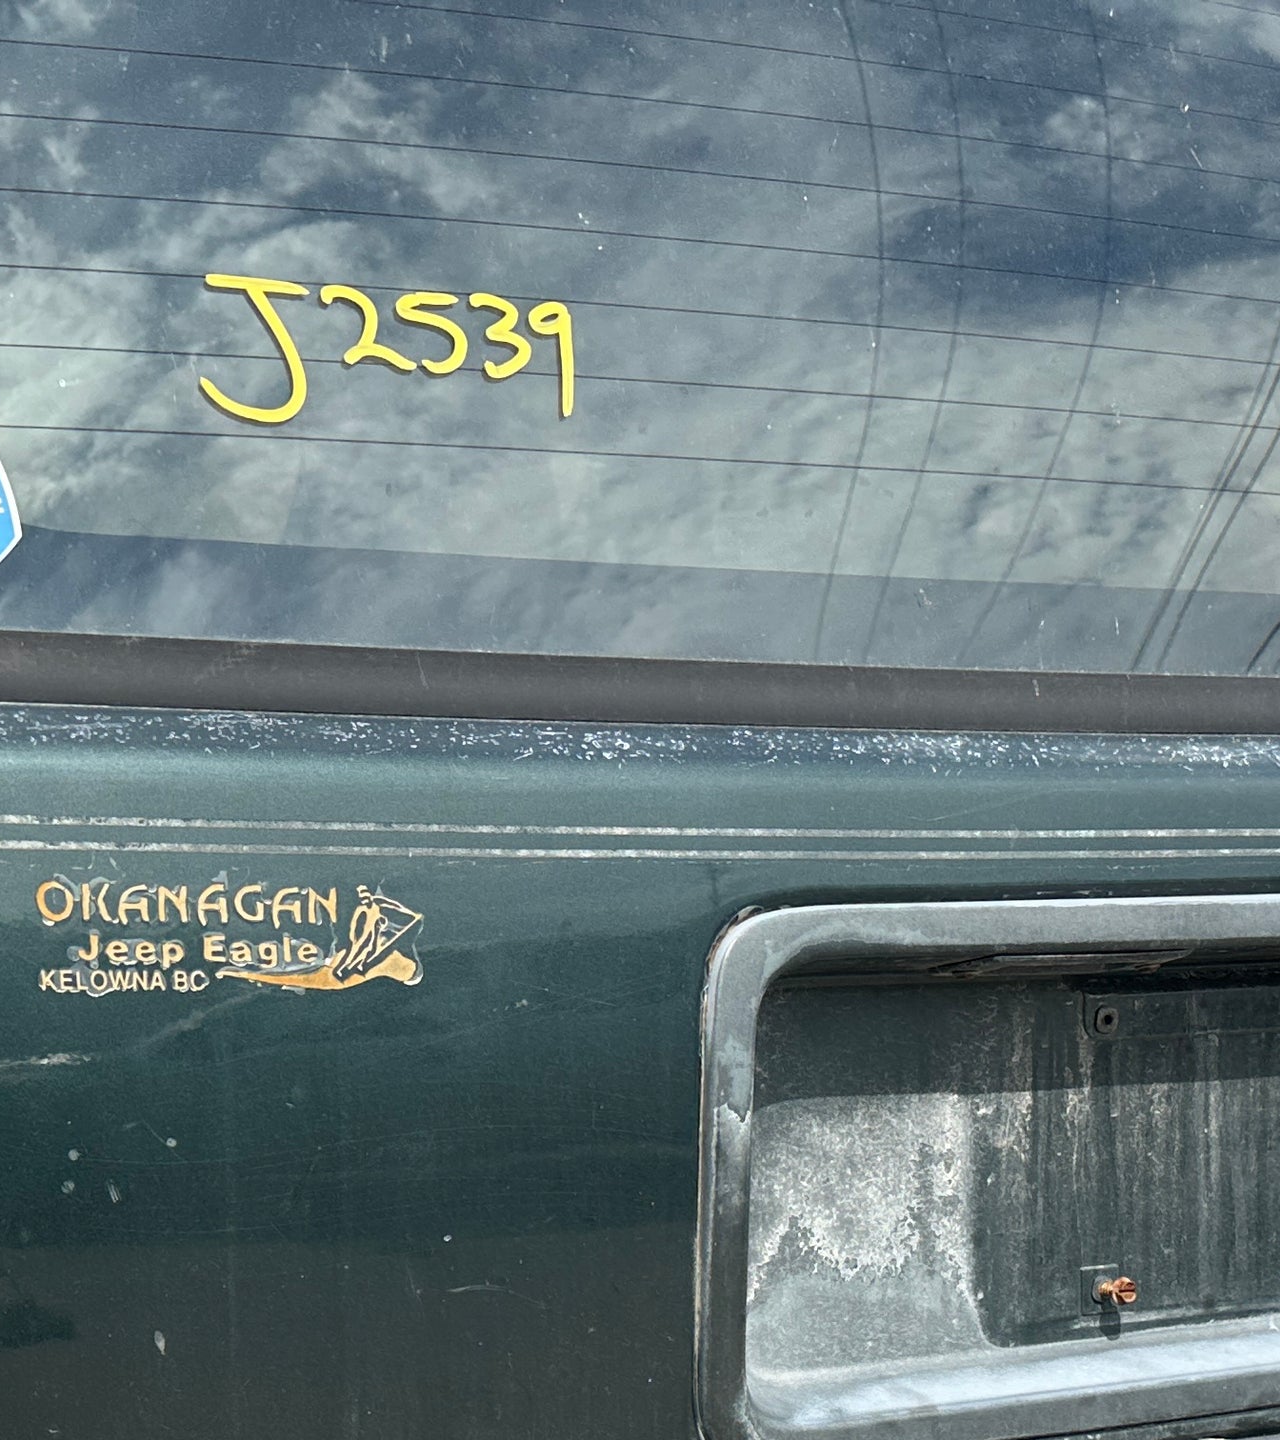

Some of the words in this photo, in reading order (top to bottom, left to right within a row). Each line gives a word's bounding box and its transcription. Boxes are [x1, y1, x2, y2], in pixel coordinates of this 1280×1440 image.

[199, 273, 575, 424] J2539
[36, 880, 337, 929] OKANAGAN
[78, 932, 186, 970] Jeep
[203, 932, 319, 968] Eagle
[39, 969, 164, 993] KELOWNA
[171, 968, 209, 992] BC
